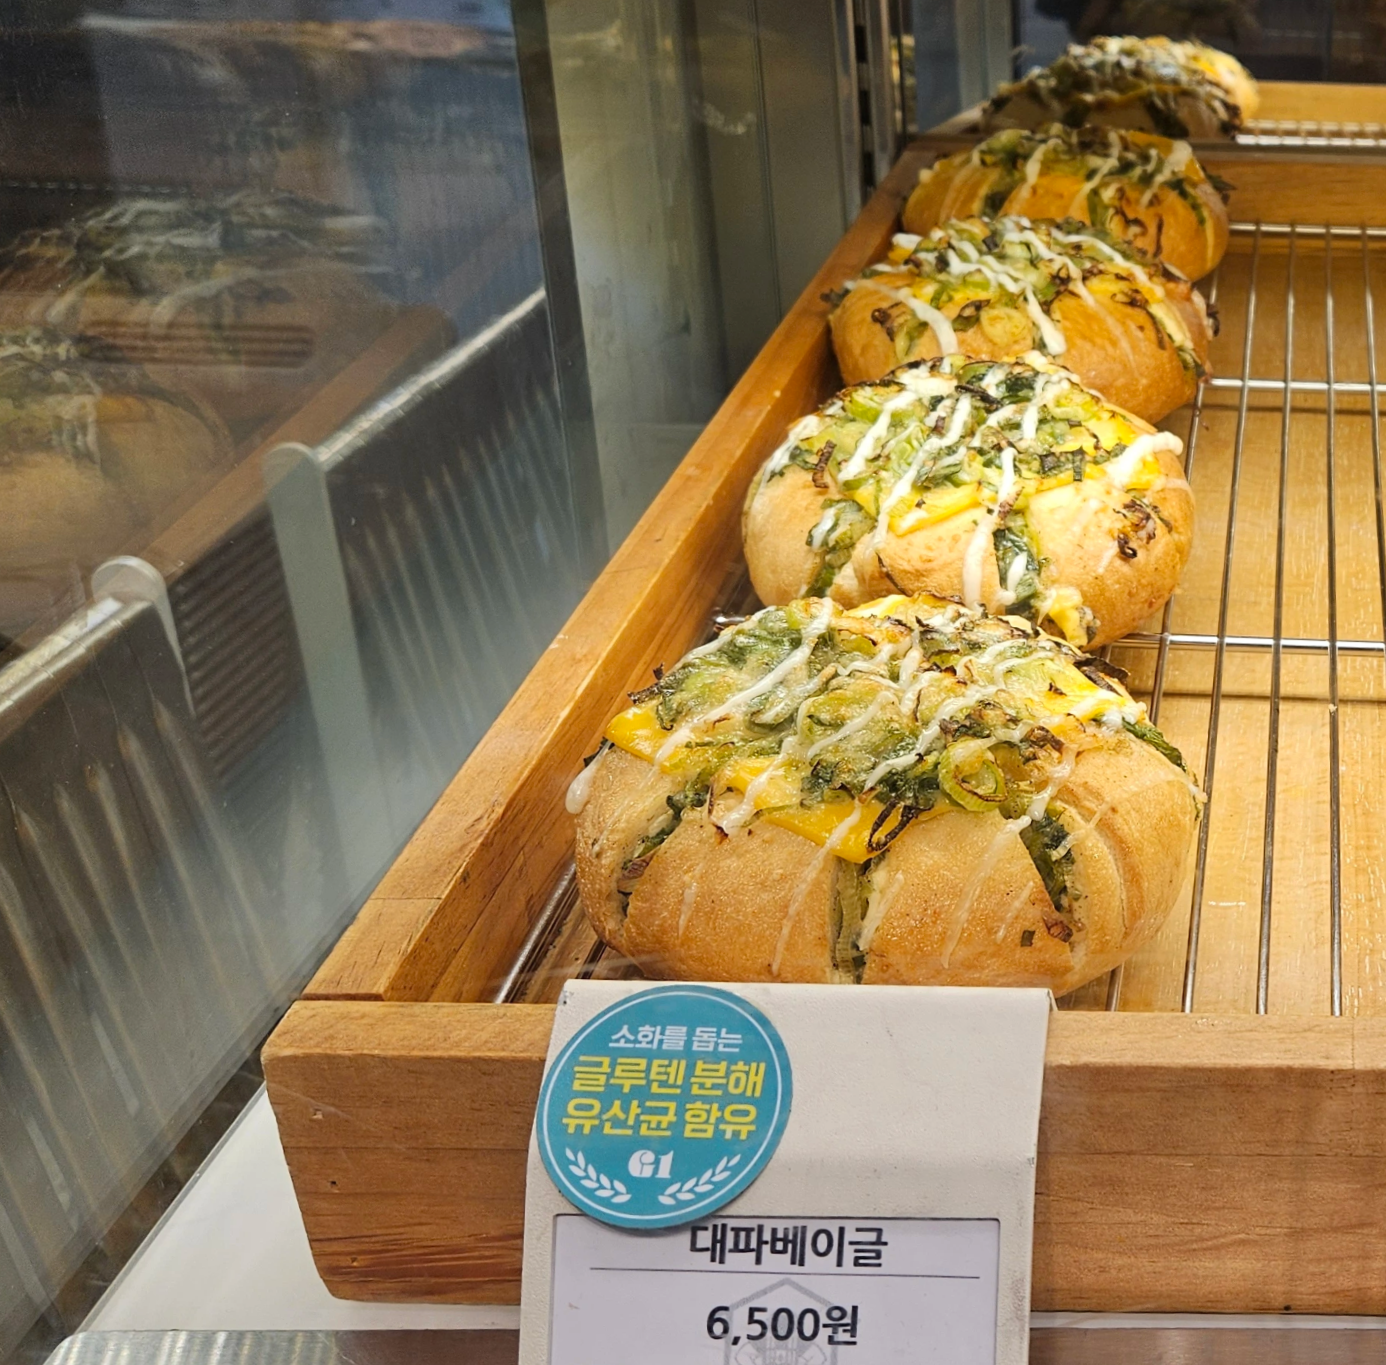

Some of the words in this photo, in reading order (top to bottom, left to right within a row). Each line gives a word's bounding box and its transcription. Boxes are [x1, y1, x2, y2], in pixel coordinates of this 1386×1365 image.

[609, 1024, 687, 1051] 소화를
[693, 1028, 743, 1052] 돕는
[573, 1056, 685, 1095] 글루텐
[689, 1062, 766, 1098] 분해
[563, 1099, 677, 1137] 유산균
[684, 1101, 757, 1140] 함유
[689, 1224, 889, 1268] 대파베이글
[706, 1306, 859, 1347] 6,500원
